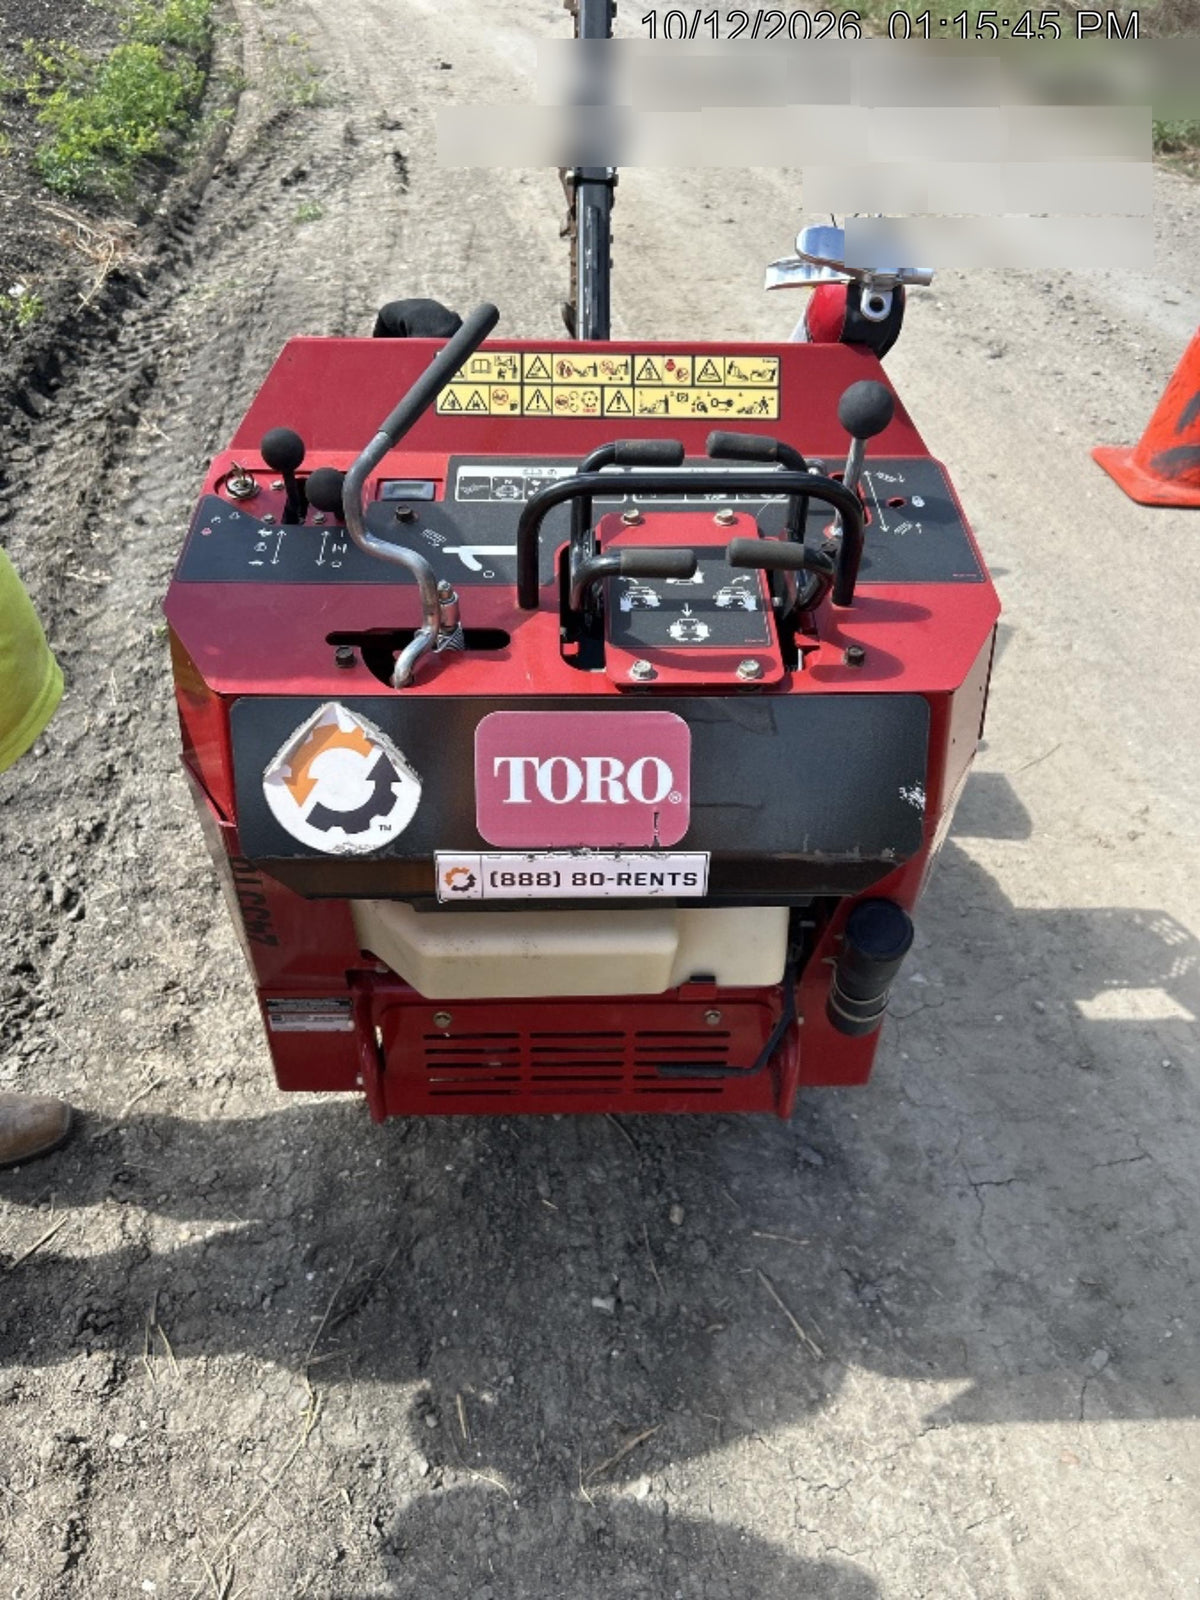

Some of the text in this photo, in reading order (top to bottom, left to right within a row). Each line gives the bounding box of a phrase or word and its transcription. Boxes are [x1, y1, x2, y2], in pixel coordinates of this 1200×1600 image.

[493, 756, 673, 804] TORO
[489, 871, 698, 888] (888) 80-RENTS
